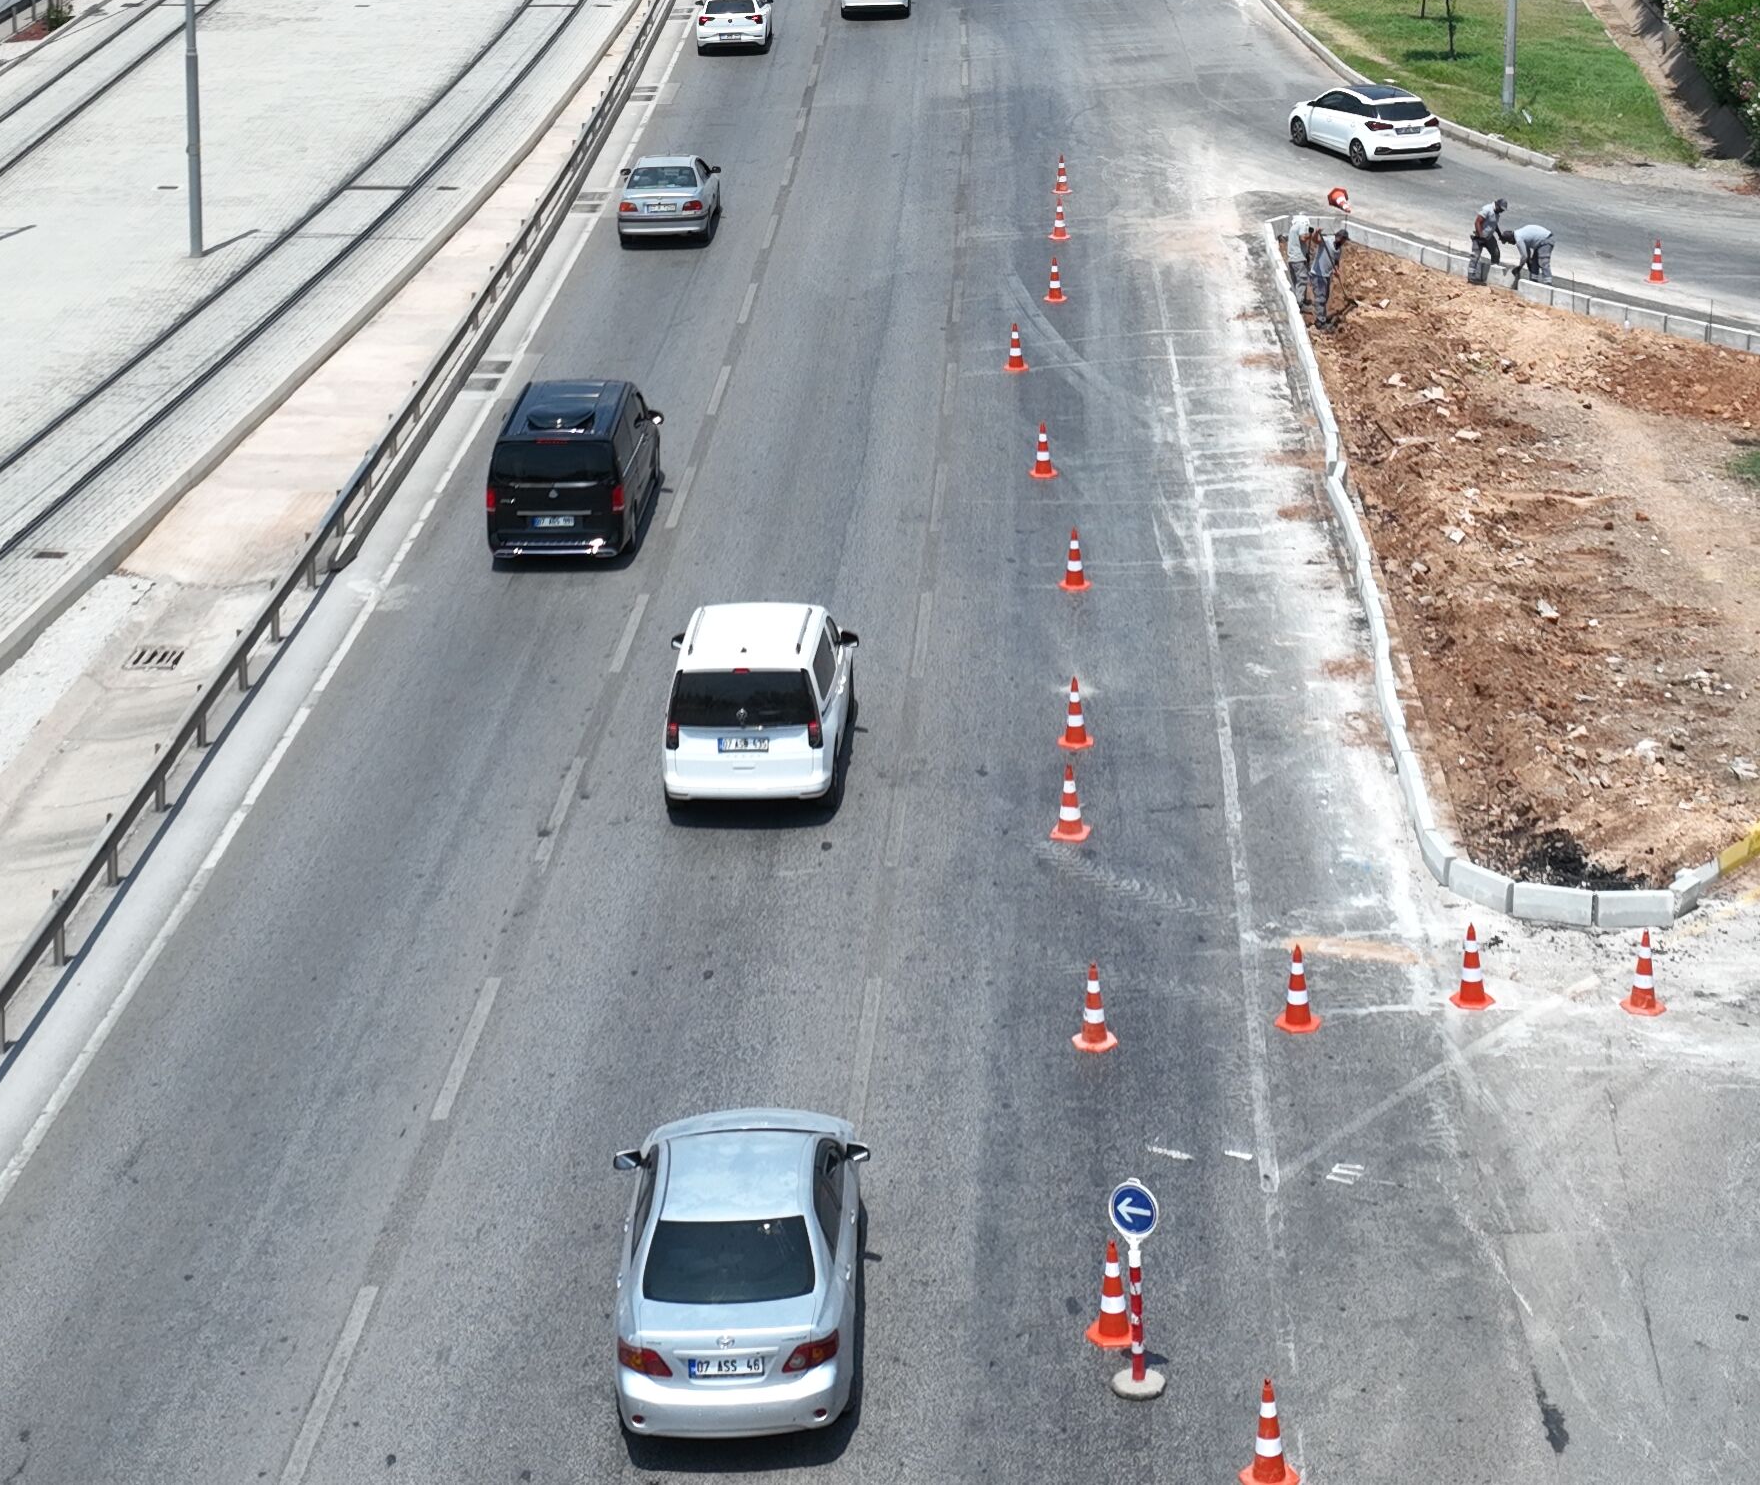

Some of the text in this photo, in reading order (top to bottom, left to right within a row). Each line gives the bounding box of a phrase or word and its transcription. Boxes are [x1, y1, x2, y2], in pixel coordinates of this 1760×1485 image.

[696, 1359, 760, 1373] 07 ASS 46
